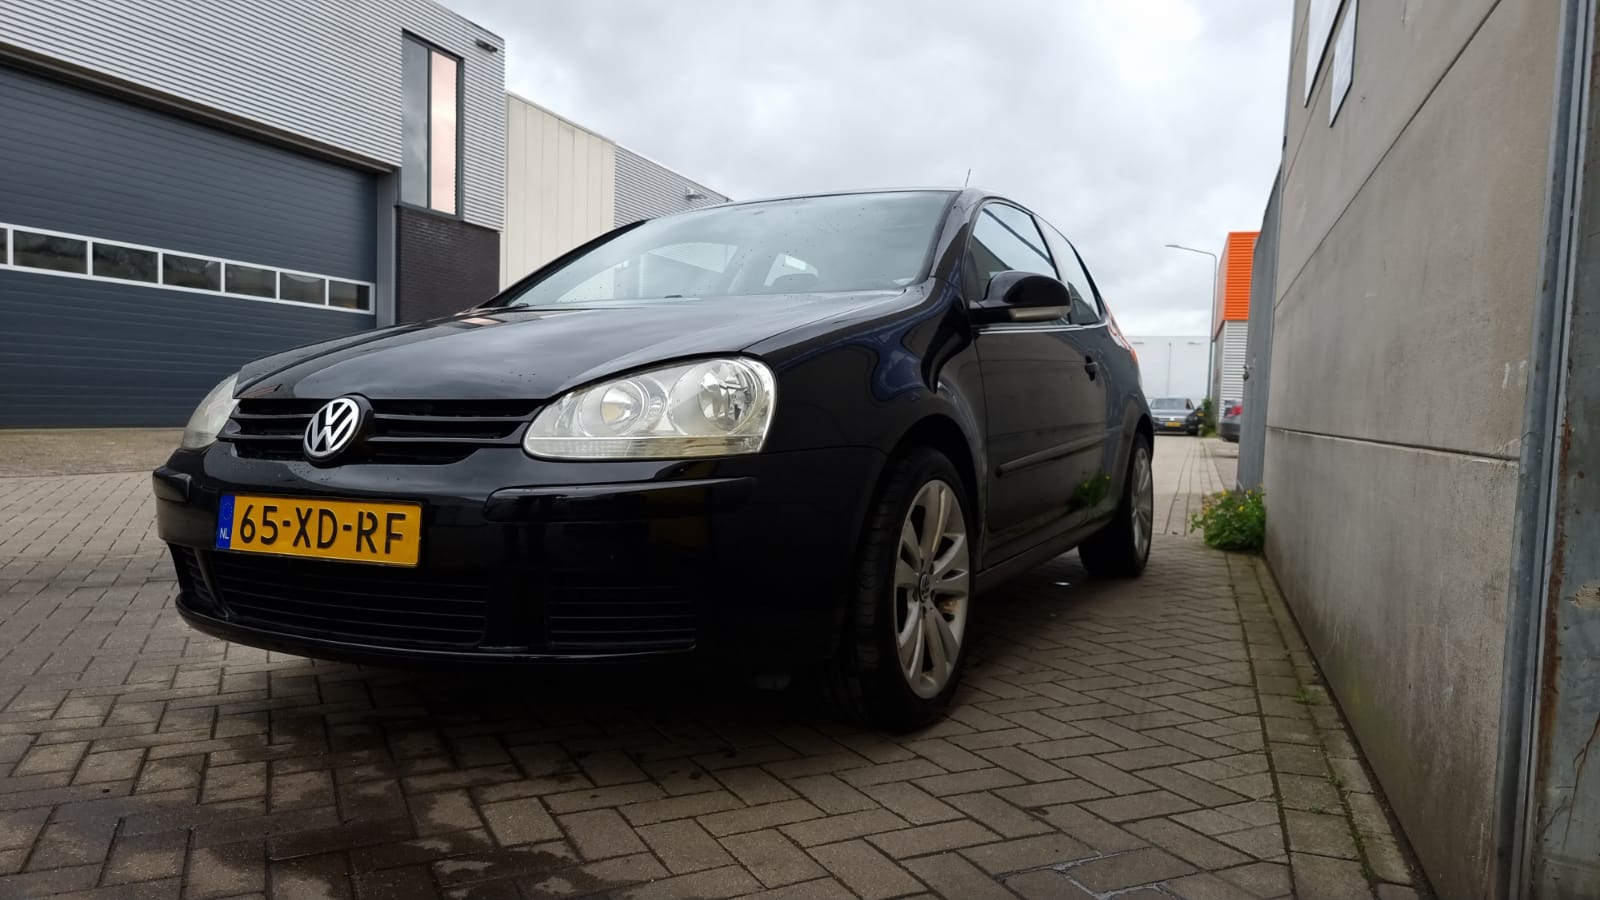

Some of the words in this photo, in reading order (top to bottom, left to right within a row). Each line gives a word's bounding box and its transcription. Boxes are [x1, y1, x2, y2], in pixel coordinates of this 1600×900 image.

[304, 398, 359, 456] VW
[219, 527, 230, 540] NL
[239, 504, 406, 554] 65-XD-RF
